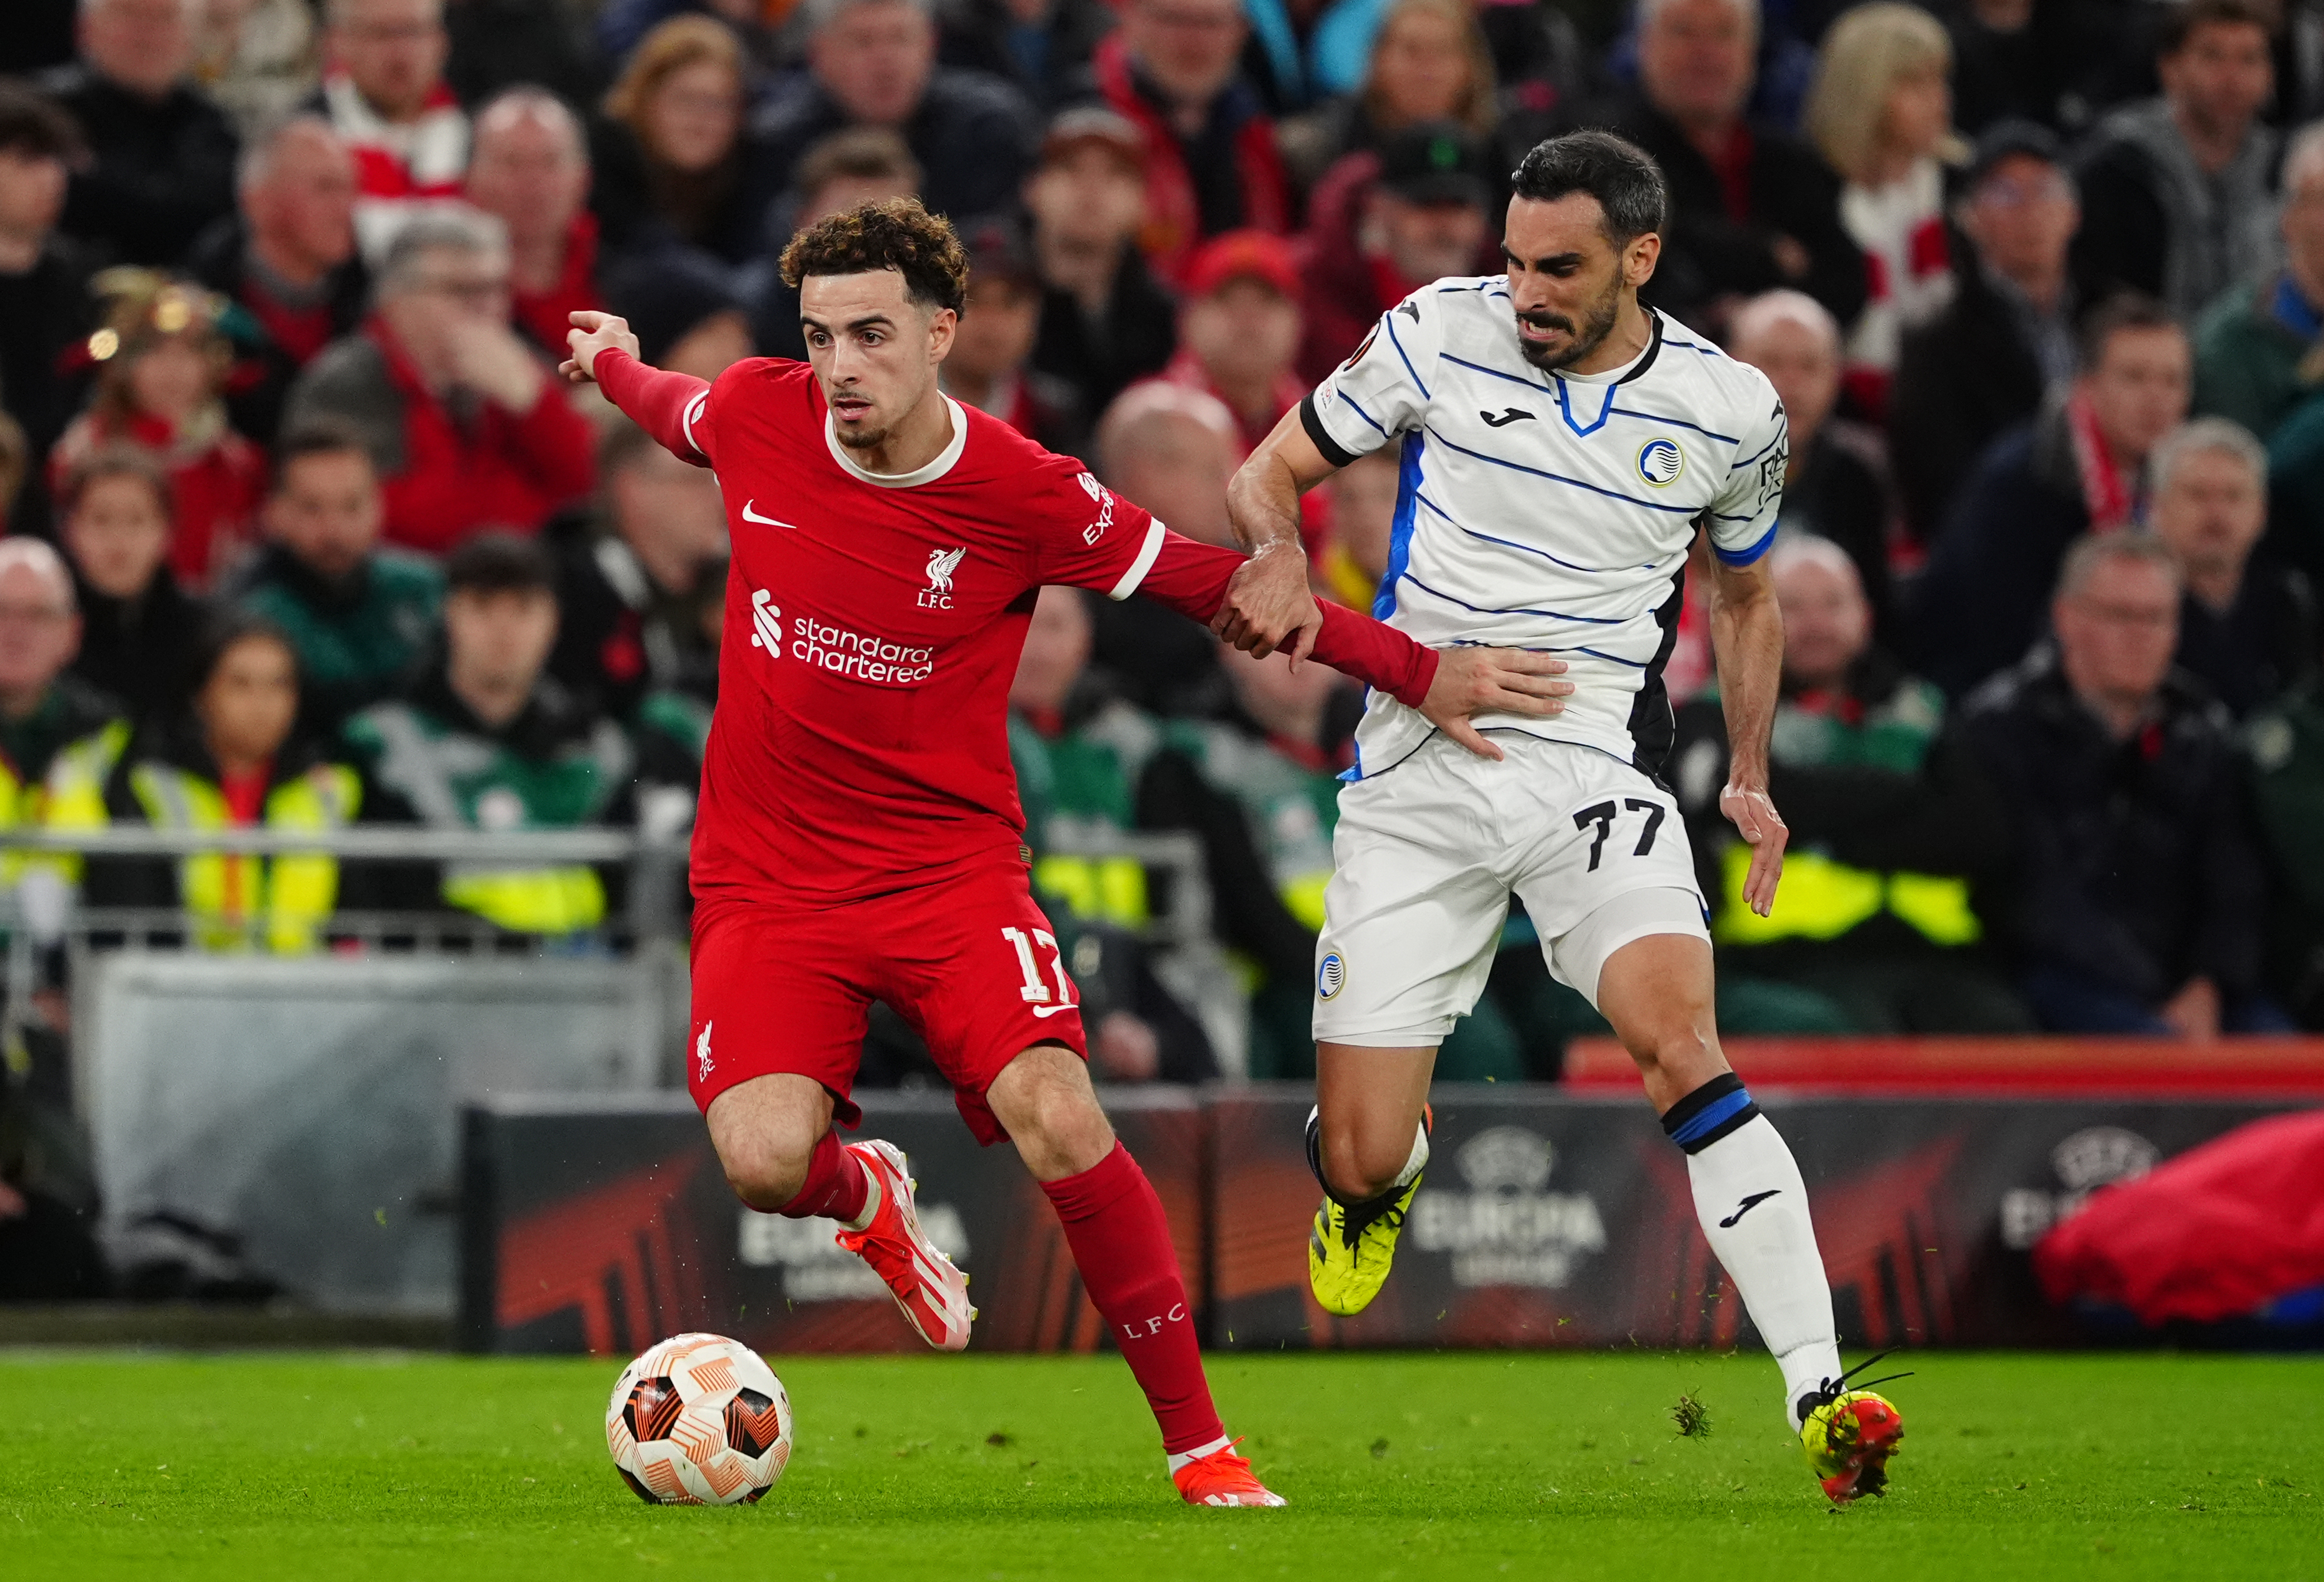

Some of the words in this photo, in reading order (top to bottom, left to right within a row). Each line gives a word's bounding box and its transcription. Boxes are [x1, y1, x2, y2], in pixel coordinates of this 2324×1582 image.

[793, 640, 932, 683] chartered
[794, 617, 934, 663] standard
[1573, 798, 1665, 873] 77
[1001, 926, 1070, 1005] 17
